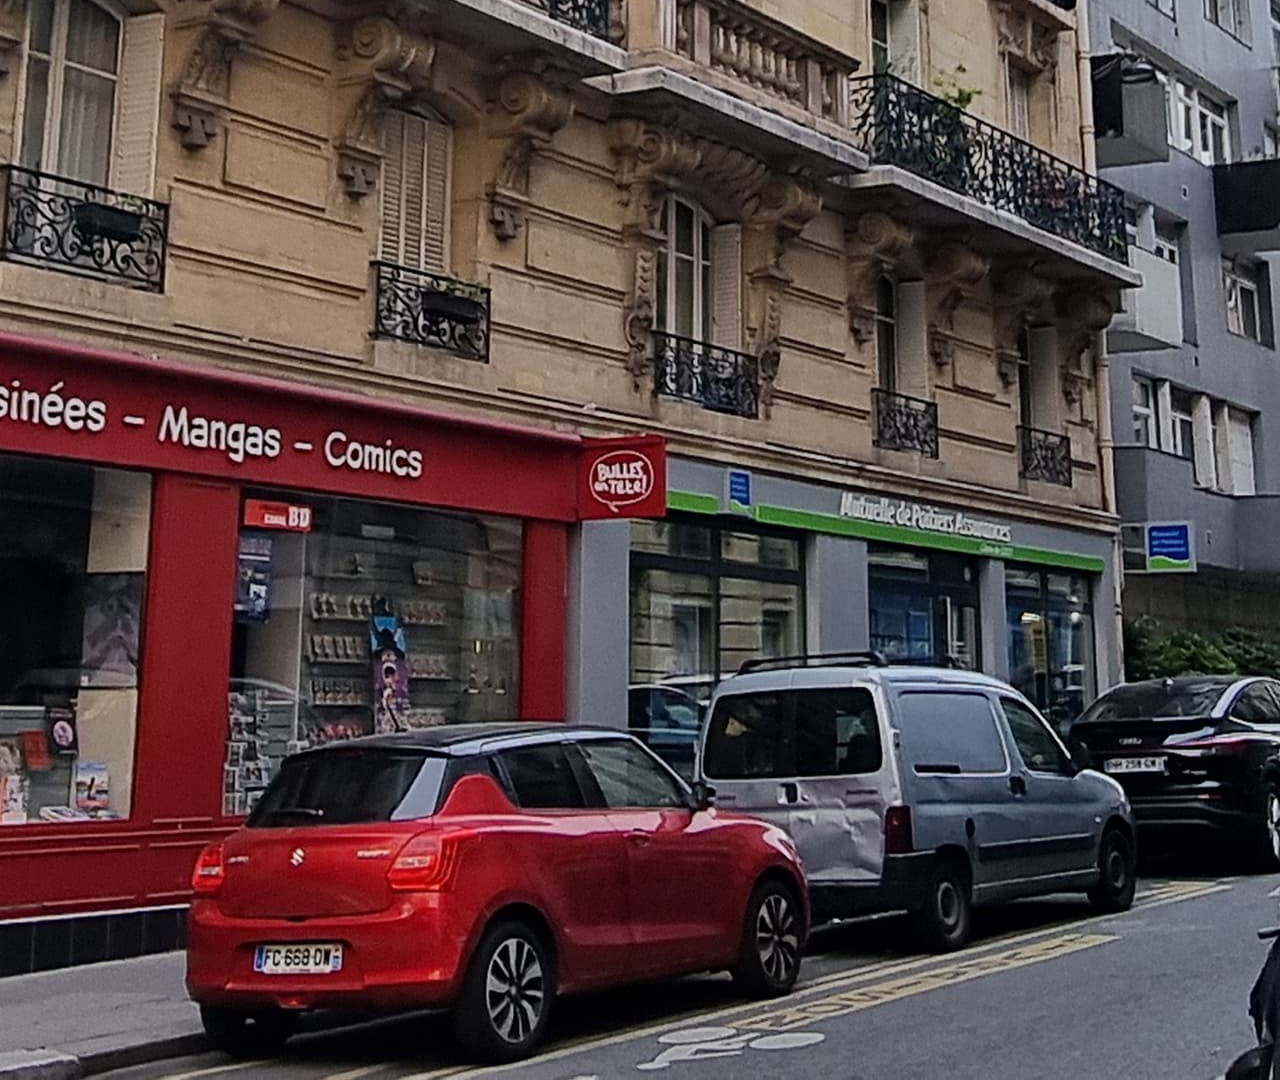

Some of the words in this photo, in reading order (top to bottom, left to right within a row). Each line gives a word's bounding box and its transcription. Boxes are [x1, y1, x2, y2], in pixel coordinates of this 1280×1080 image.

[158, 405, 281, 463] Mangas
[324, 431, 423, 478] Comics
[597, 460, 644, 482] BULLES
[288, 505, 311, 528] BD
[841, 491, 895, 524] Mutuelle
[895, 500, 912, 526] de
